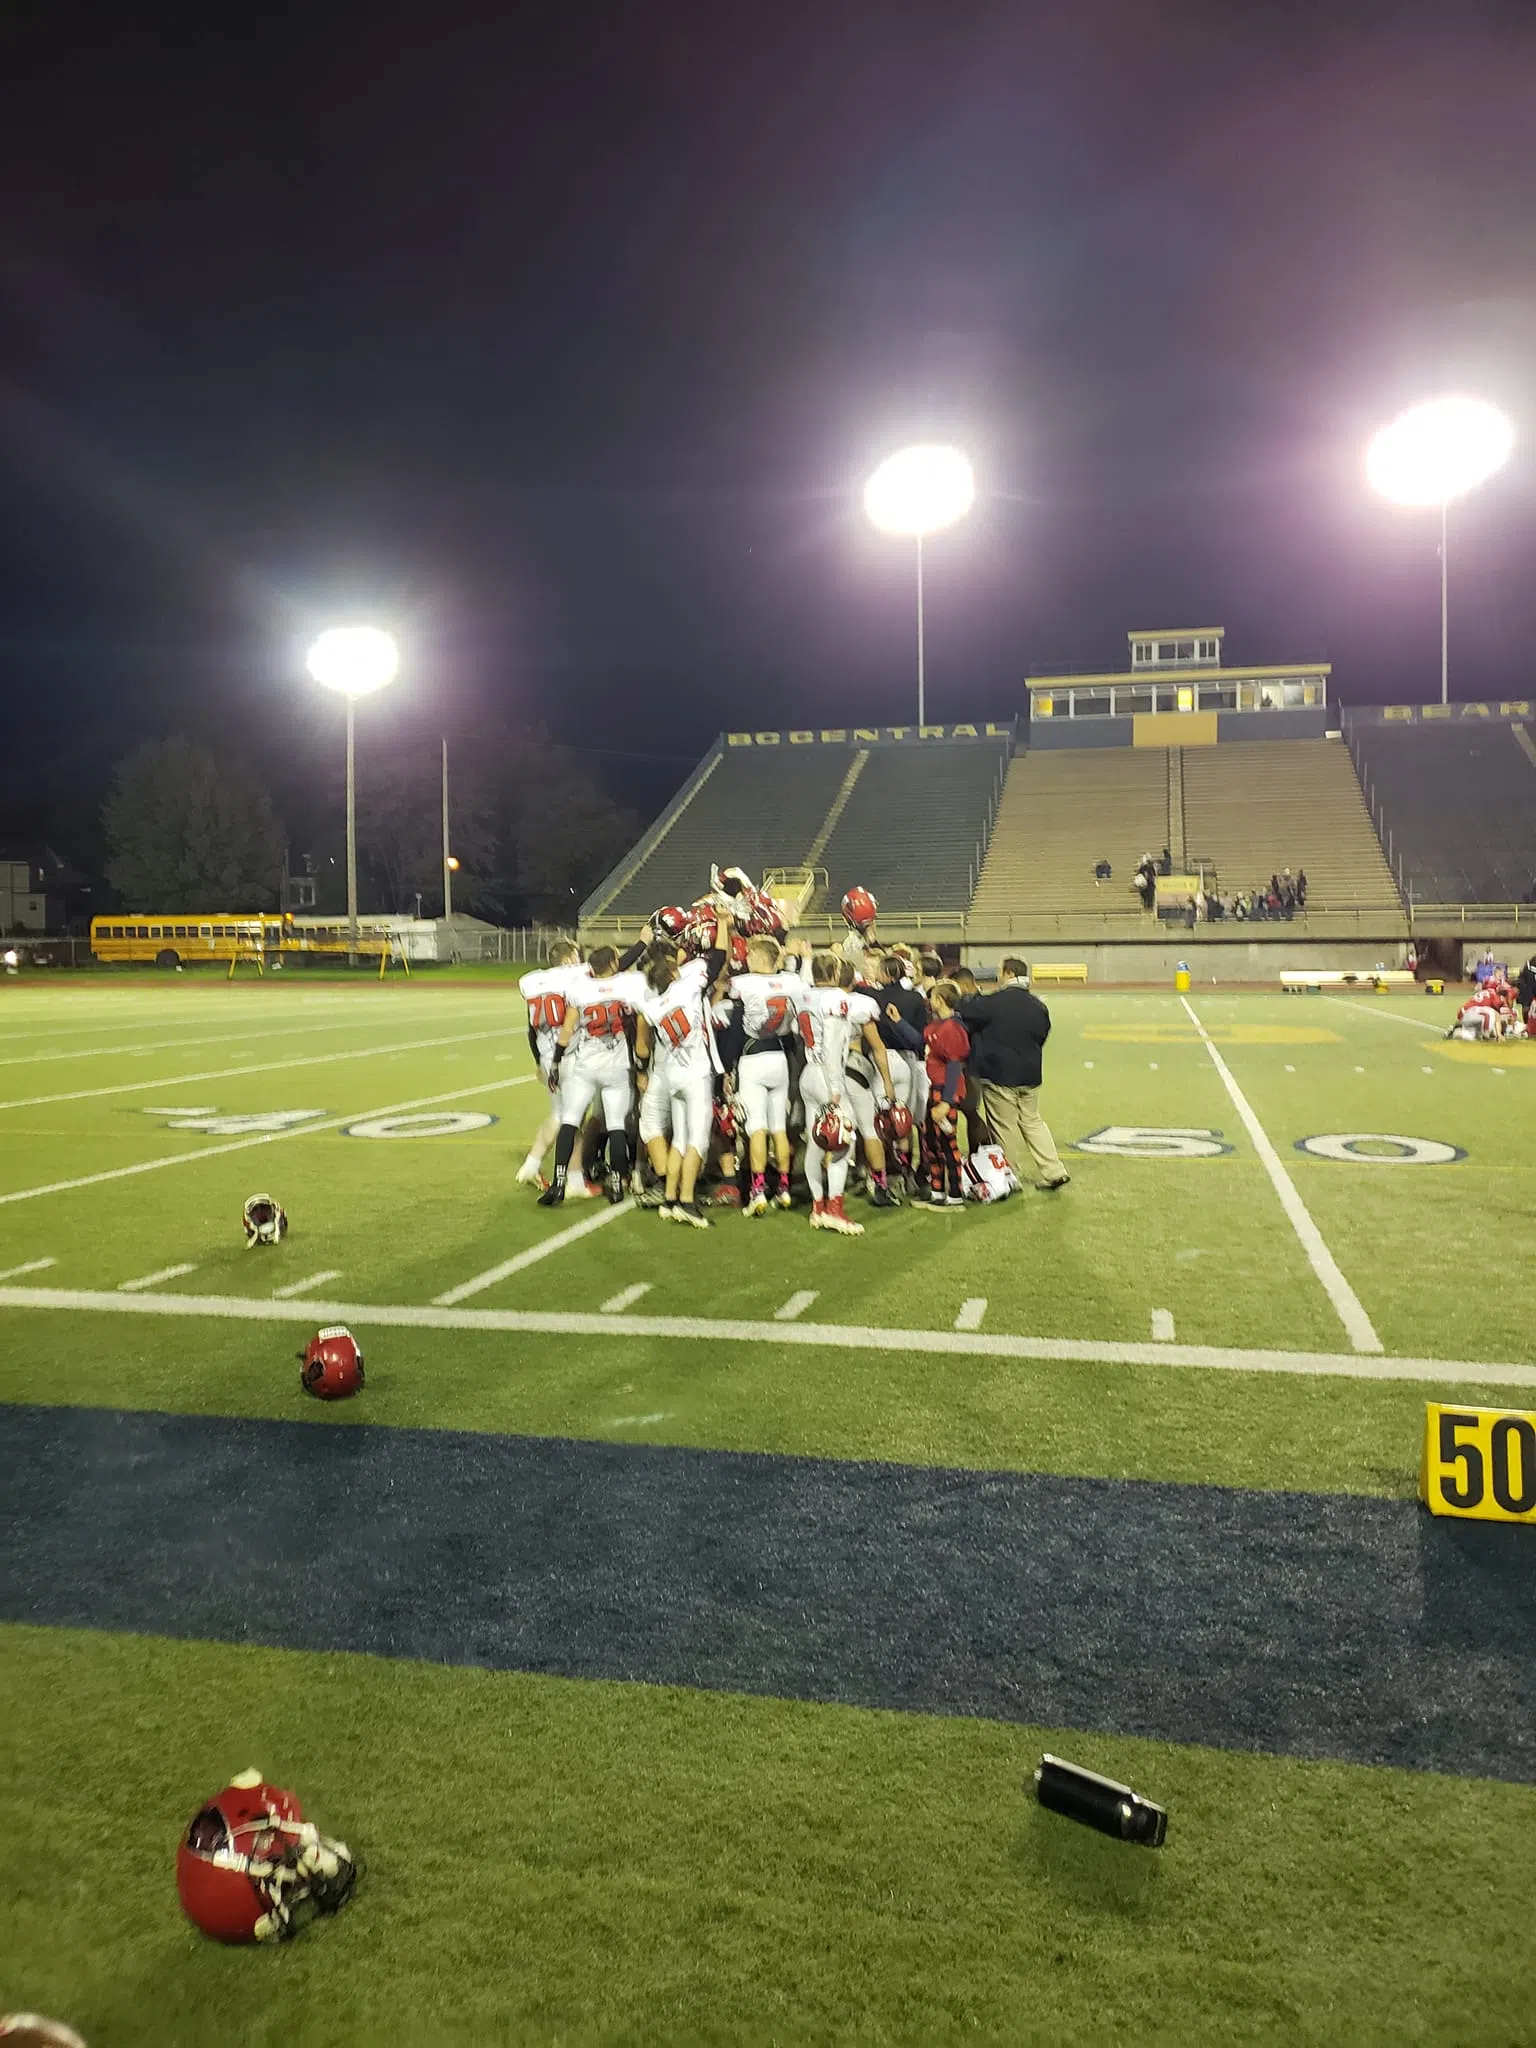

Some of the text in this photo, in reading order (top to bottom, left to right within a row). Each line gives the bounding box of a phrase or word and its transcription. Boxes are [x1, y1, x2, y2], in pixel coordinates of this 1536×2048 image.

[527, 993, 566, 1029] 70
[660, 1007, 692, 1048] 11
[760, 995, 788, 1038] 7
[1439, 1413, 1536, 1513] 50
